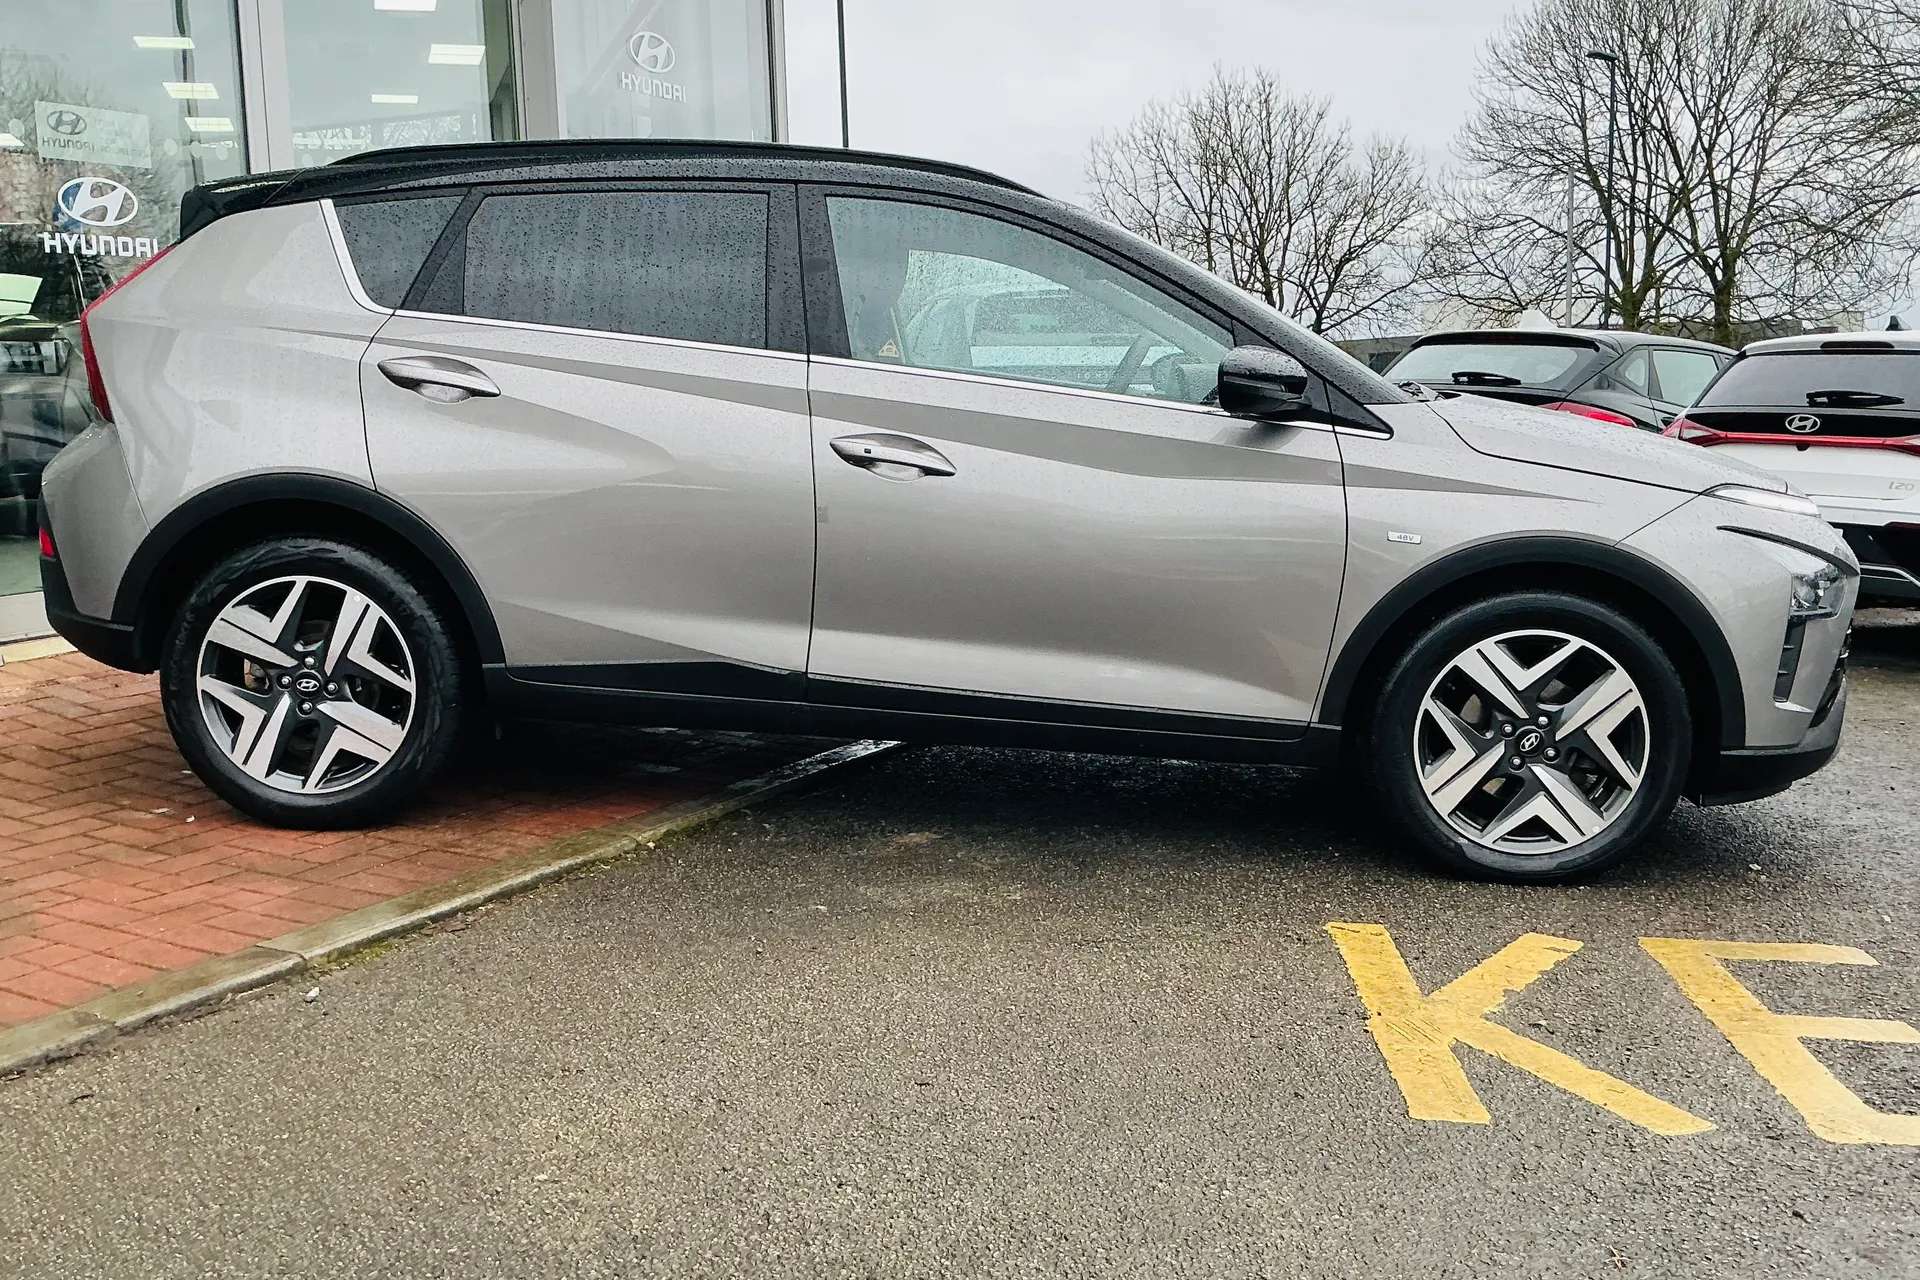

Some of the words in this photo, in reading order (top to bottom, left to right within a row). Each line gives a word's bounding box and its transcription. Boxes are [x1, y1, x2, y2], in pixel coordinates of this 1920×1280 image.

[621, 72, 686, 103] HYUNDAI
[41, 136, 95, 153] HYUNDAI
[43, 231, 159, 258] HYUNDAI
